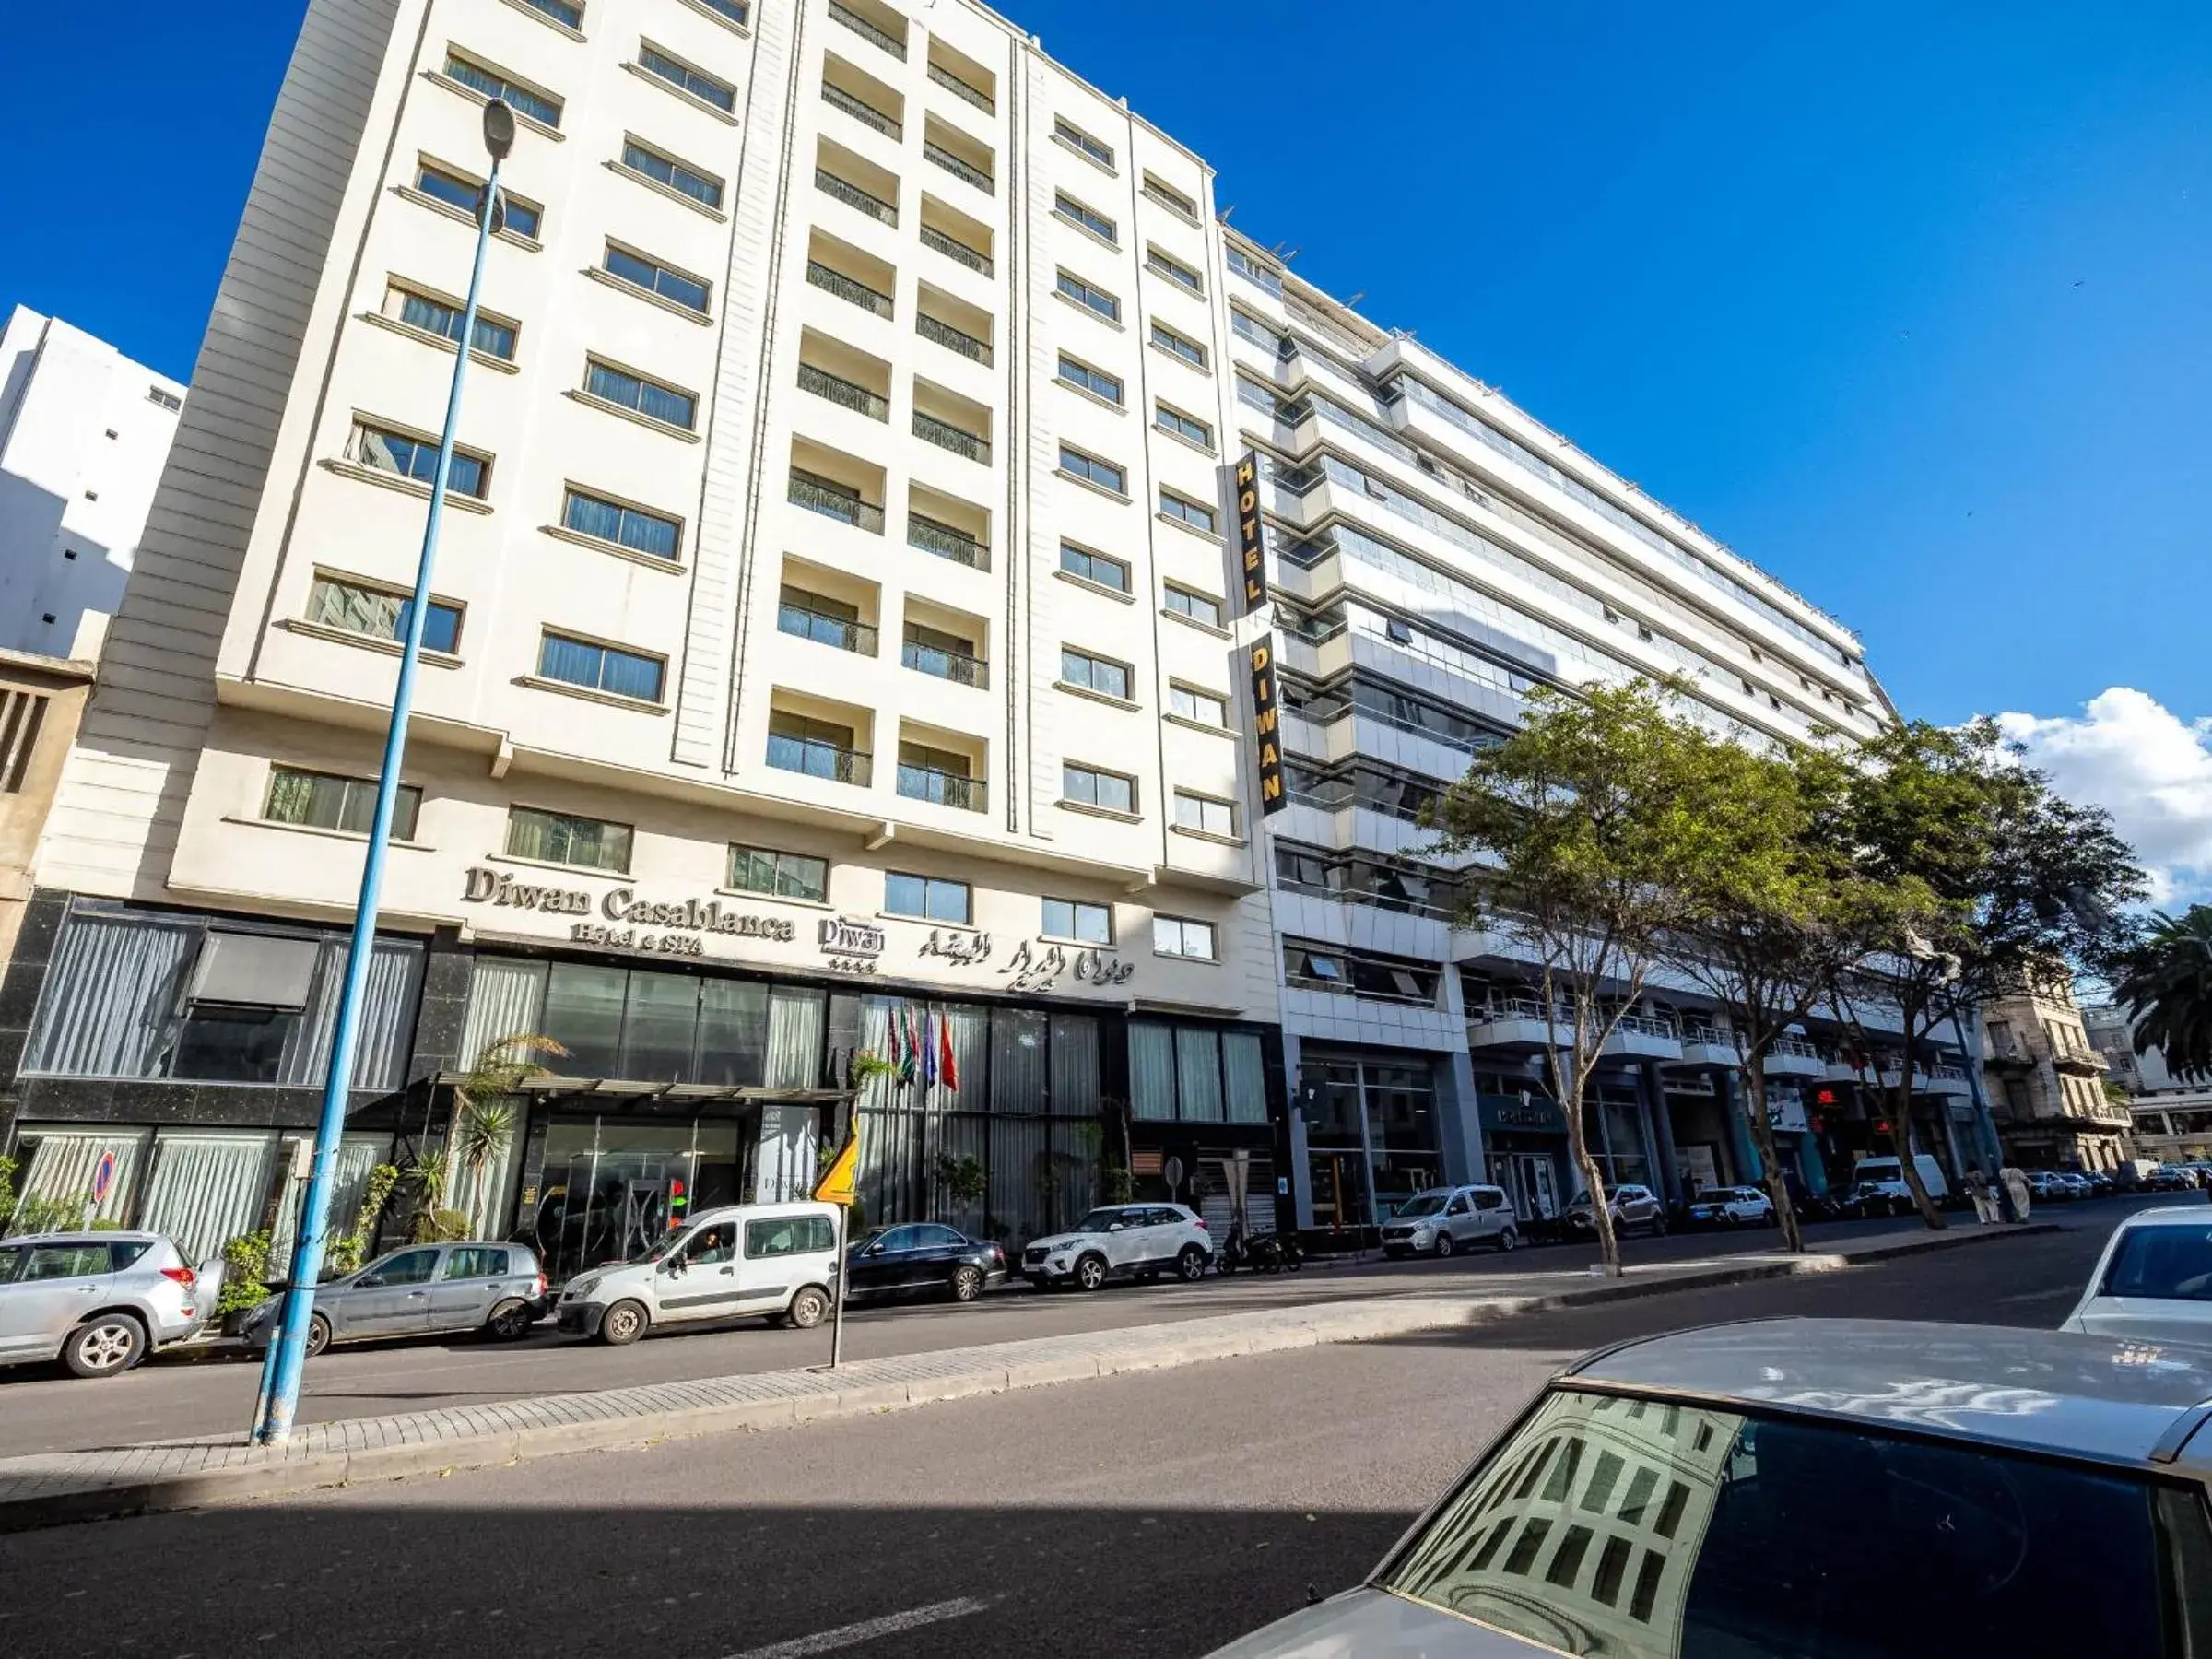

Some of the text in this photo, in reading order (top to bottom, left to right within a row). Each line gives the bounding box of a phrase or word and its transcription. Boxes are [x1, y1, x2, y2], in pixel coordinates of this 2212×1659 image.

[1237, 462, 1281, 802] HOTEL DIWAN
[460, 866, 796, 942] Diwan Casablanca
[658, 935, 705, 957] SPA
[818, 918, 885, 952] Diwan
